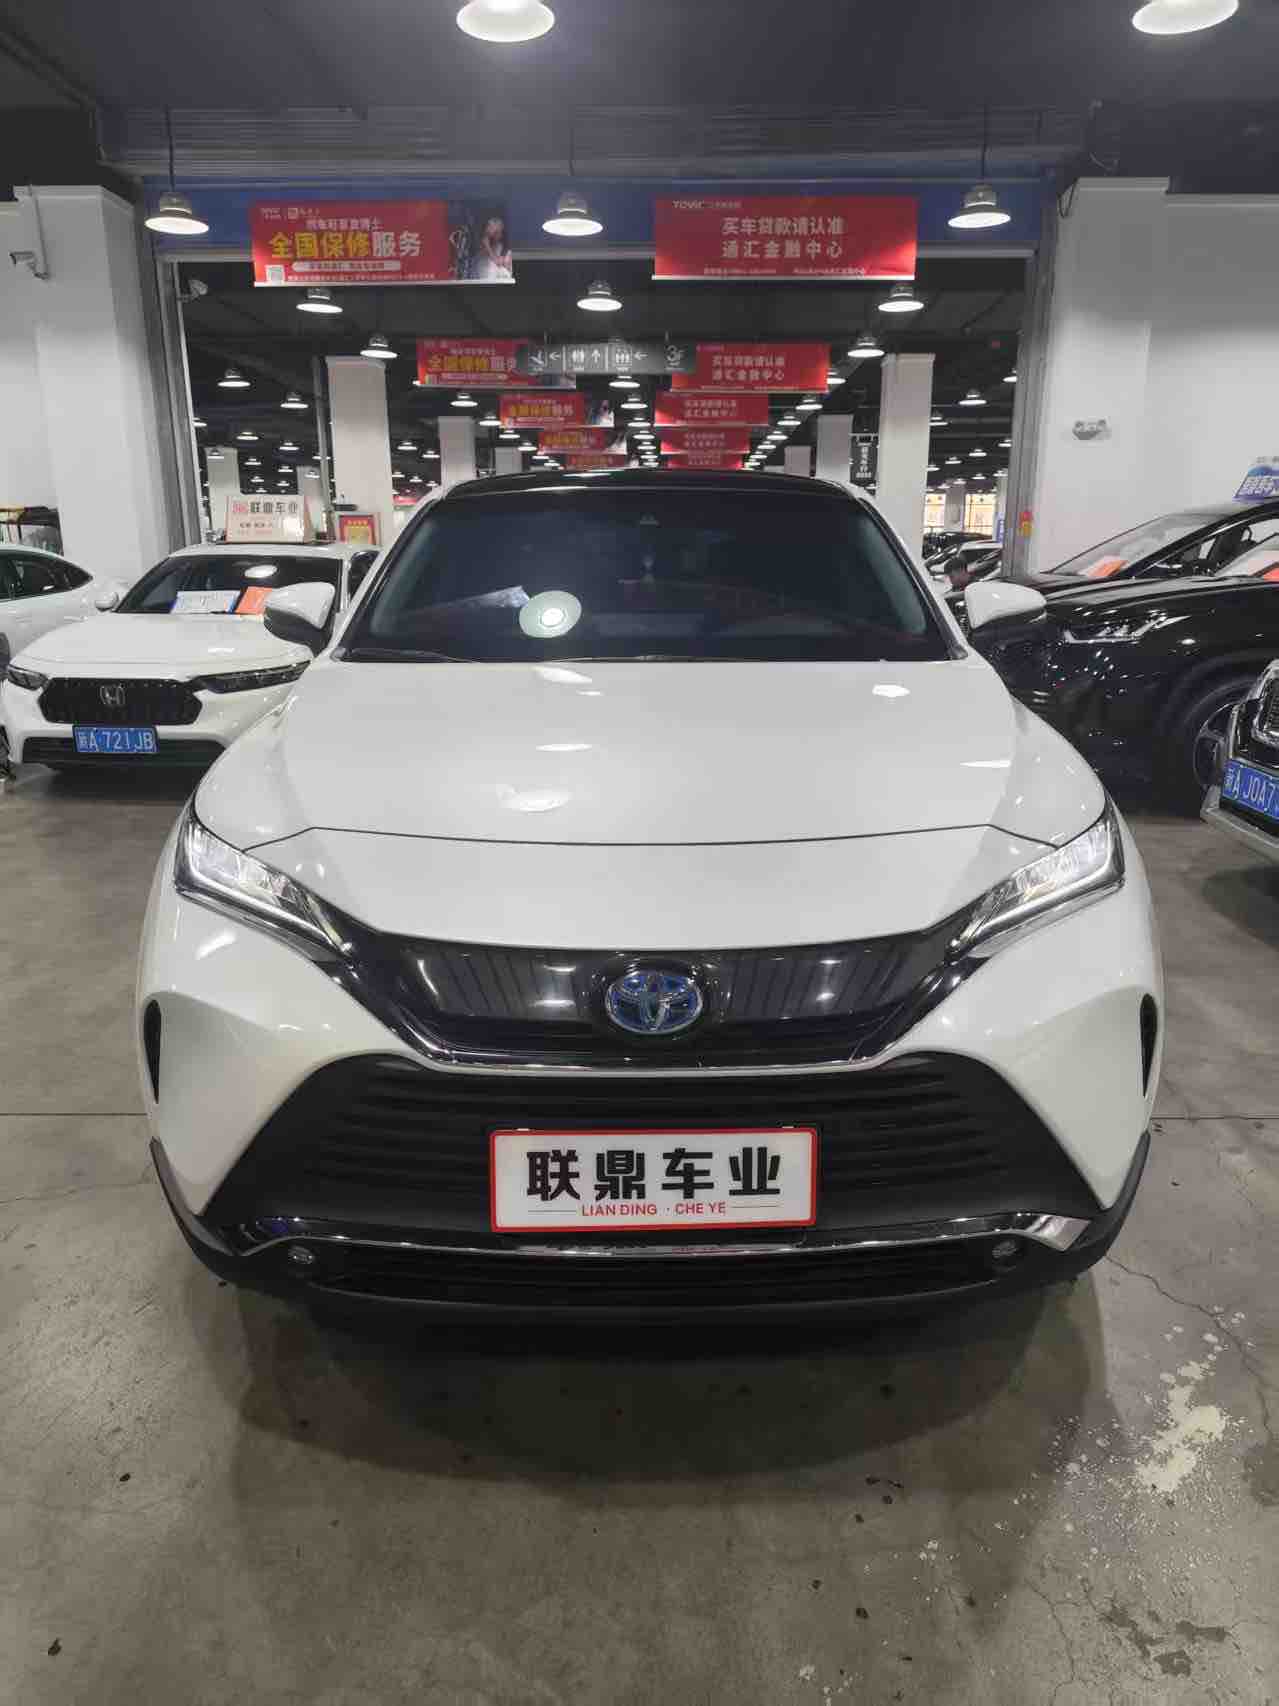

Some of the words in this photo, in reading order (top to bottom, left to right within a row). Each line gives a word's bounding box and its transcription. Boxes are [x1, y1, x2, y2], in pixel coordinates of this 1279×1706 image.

[721, 216, 846, 236] 买车贷款请认准
[270, 230, 422, 259] 全国保修服务
[722, 240, 844, 261] 通汇金融中心
[527, 1146, 781, 1202] 联鼎车业
[582, 1203, 616, 1216] LIAN
[620, 1203, 657, 1216] DING
[675, 1202, 704, 1215] CHE
[706, 1201, 726, 1214] YE
